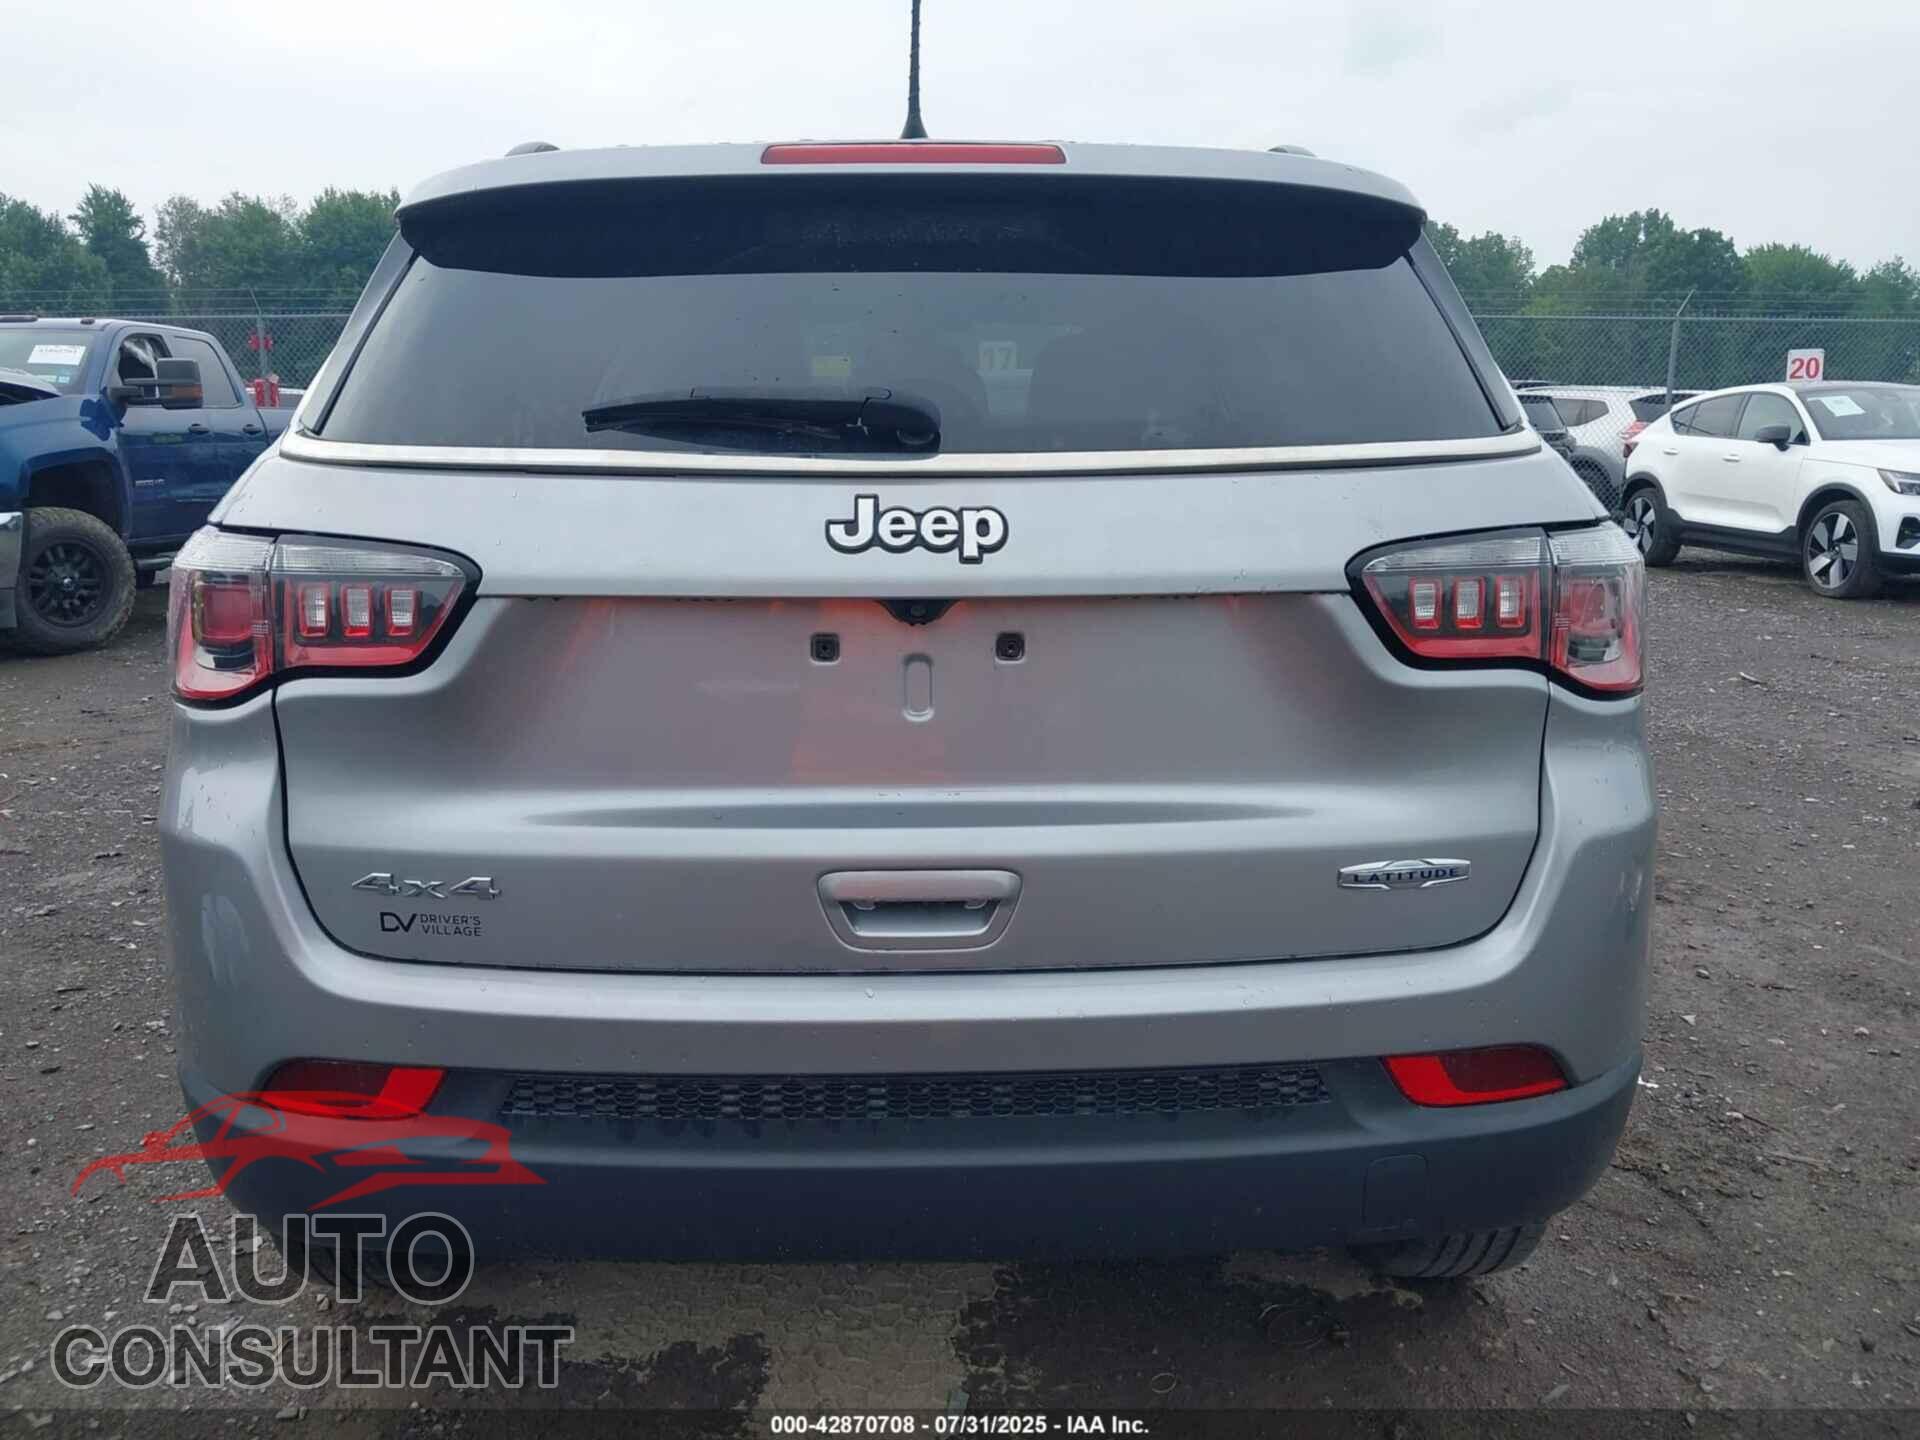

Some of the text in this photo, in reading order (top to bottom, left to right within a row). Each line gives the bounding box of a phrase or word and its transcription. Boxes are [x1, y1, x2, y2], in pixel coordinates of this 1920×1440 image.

[1790, 357, 1820, 380] 20
[825, 494, 1009, 564] Jeep
[1353, 868, 1459, 884] LATITUDE
[380, 911, 417, 933] DV
[420, 913, 481, 926] DRIVER'S
[422, 924, 482, 937] VILLAGE
